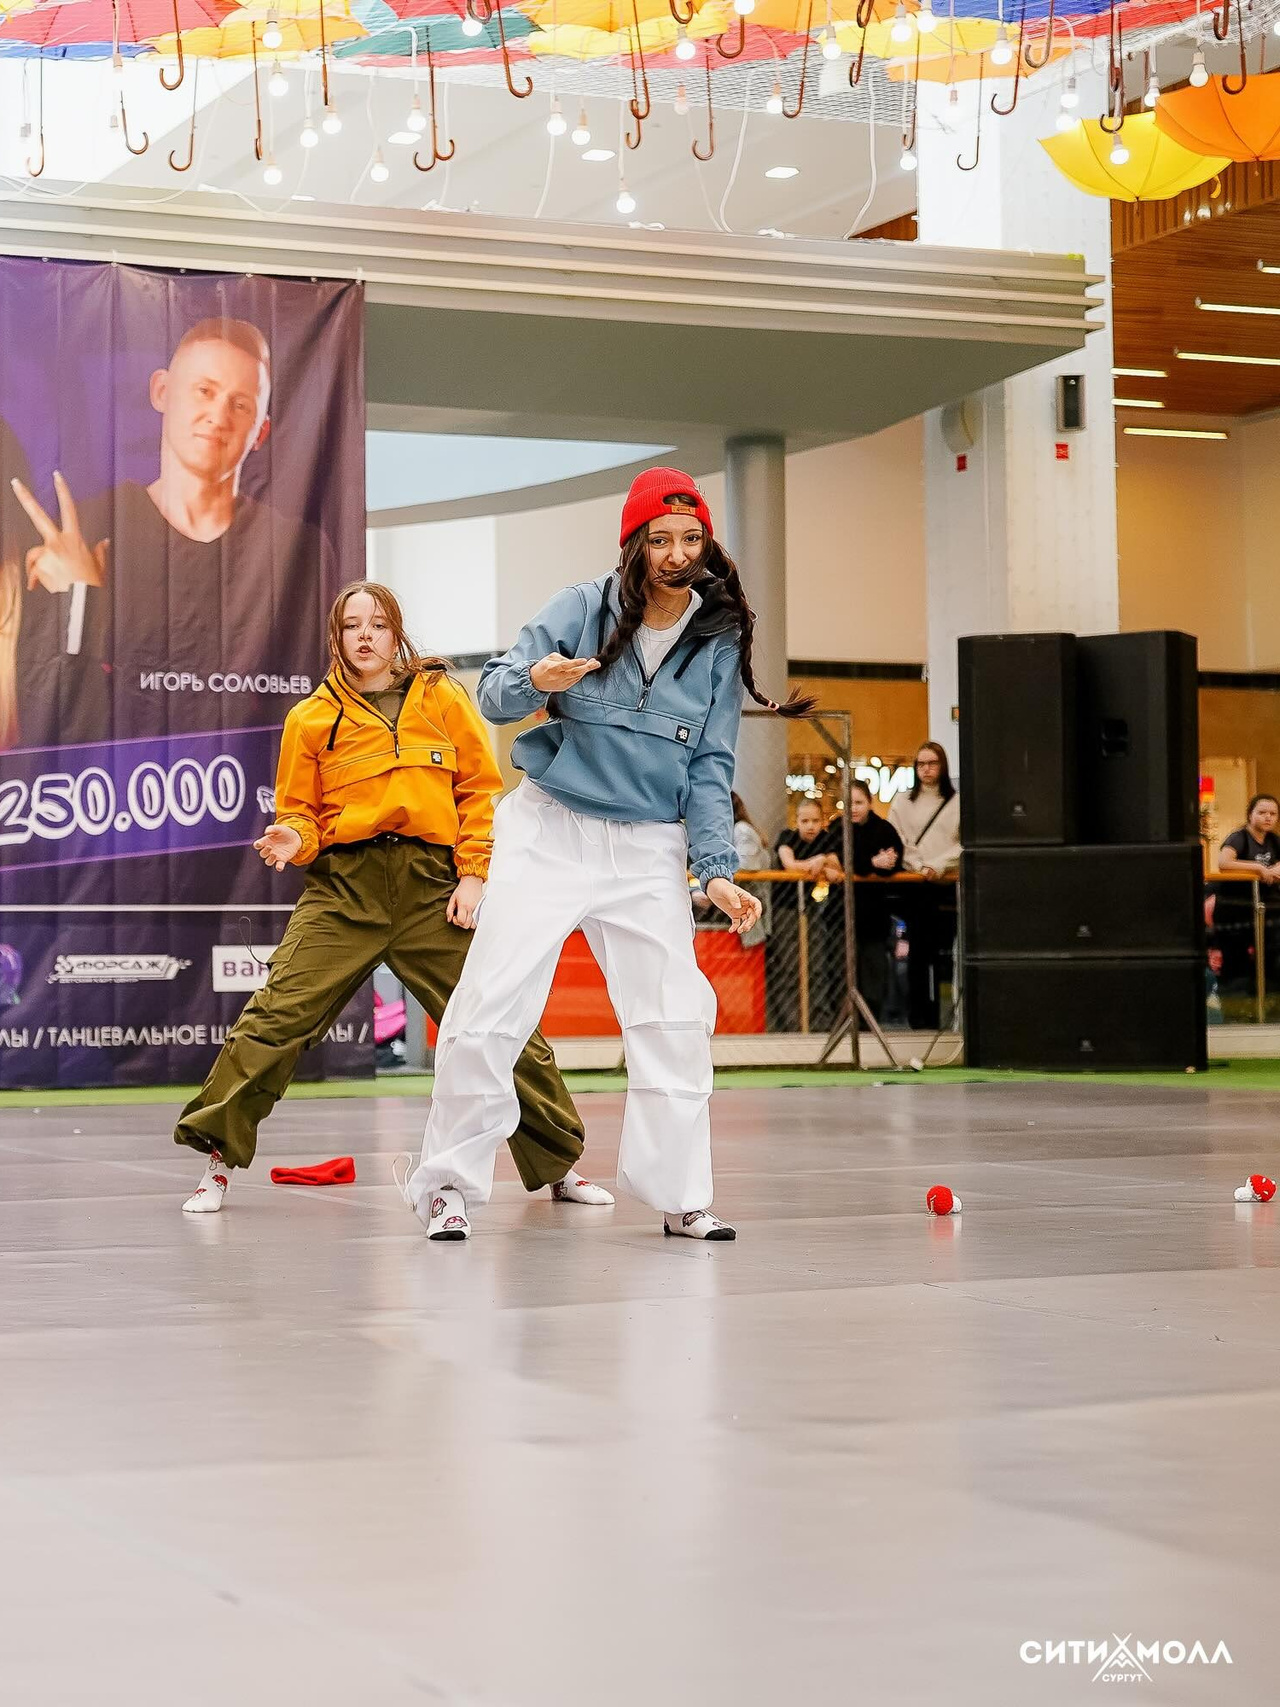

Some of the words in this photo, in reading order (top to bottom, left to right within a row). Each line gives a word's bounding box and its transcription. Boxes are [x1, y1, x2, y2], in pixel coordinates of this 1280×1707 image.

[140, 671, 205, 691] ИГОРЬ
[207, 672, 313, 694] СОЛОВЬЕВ
[47, 1024, 207, 1049] ТАНЦЕВАЛЬНОЕ
